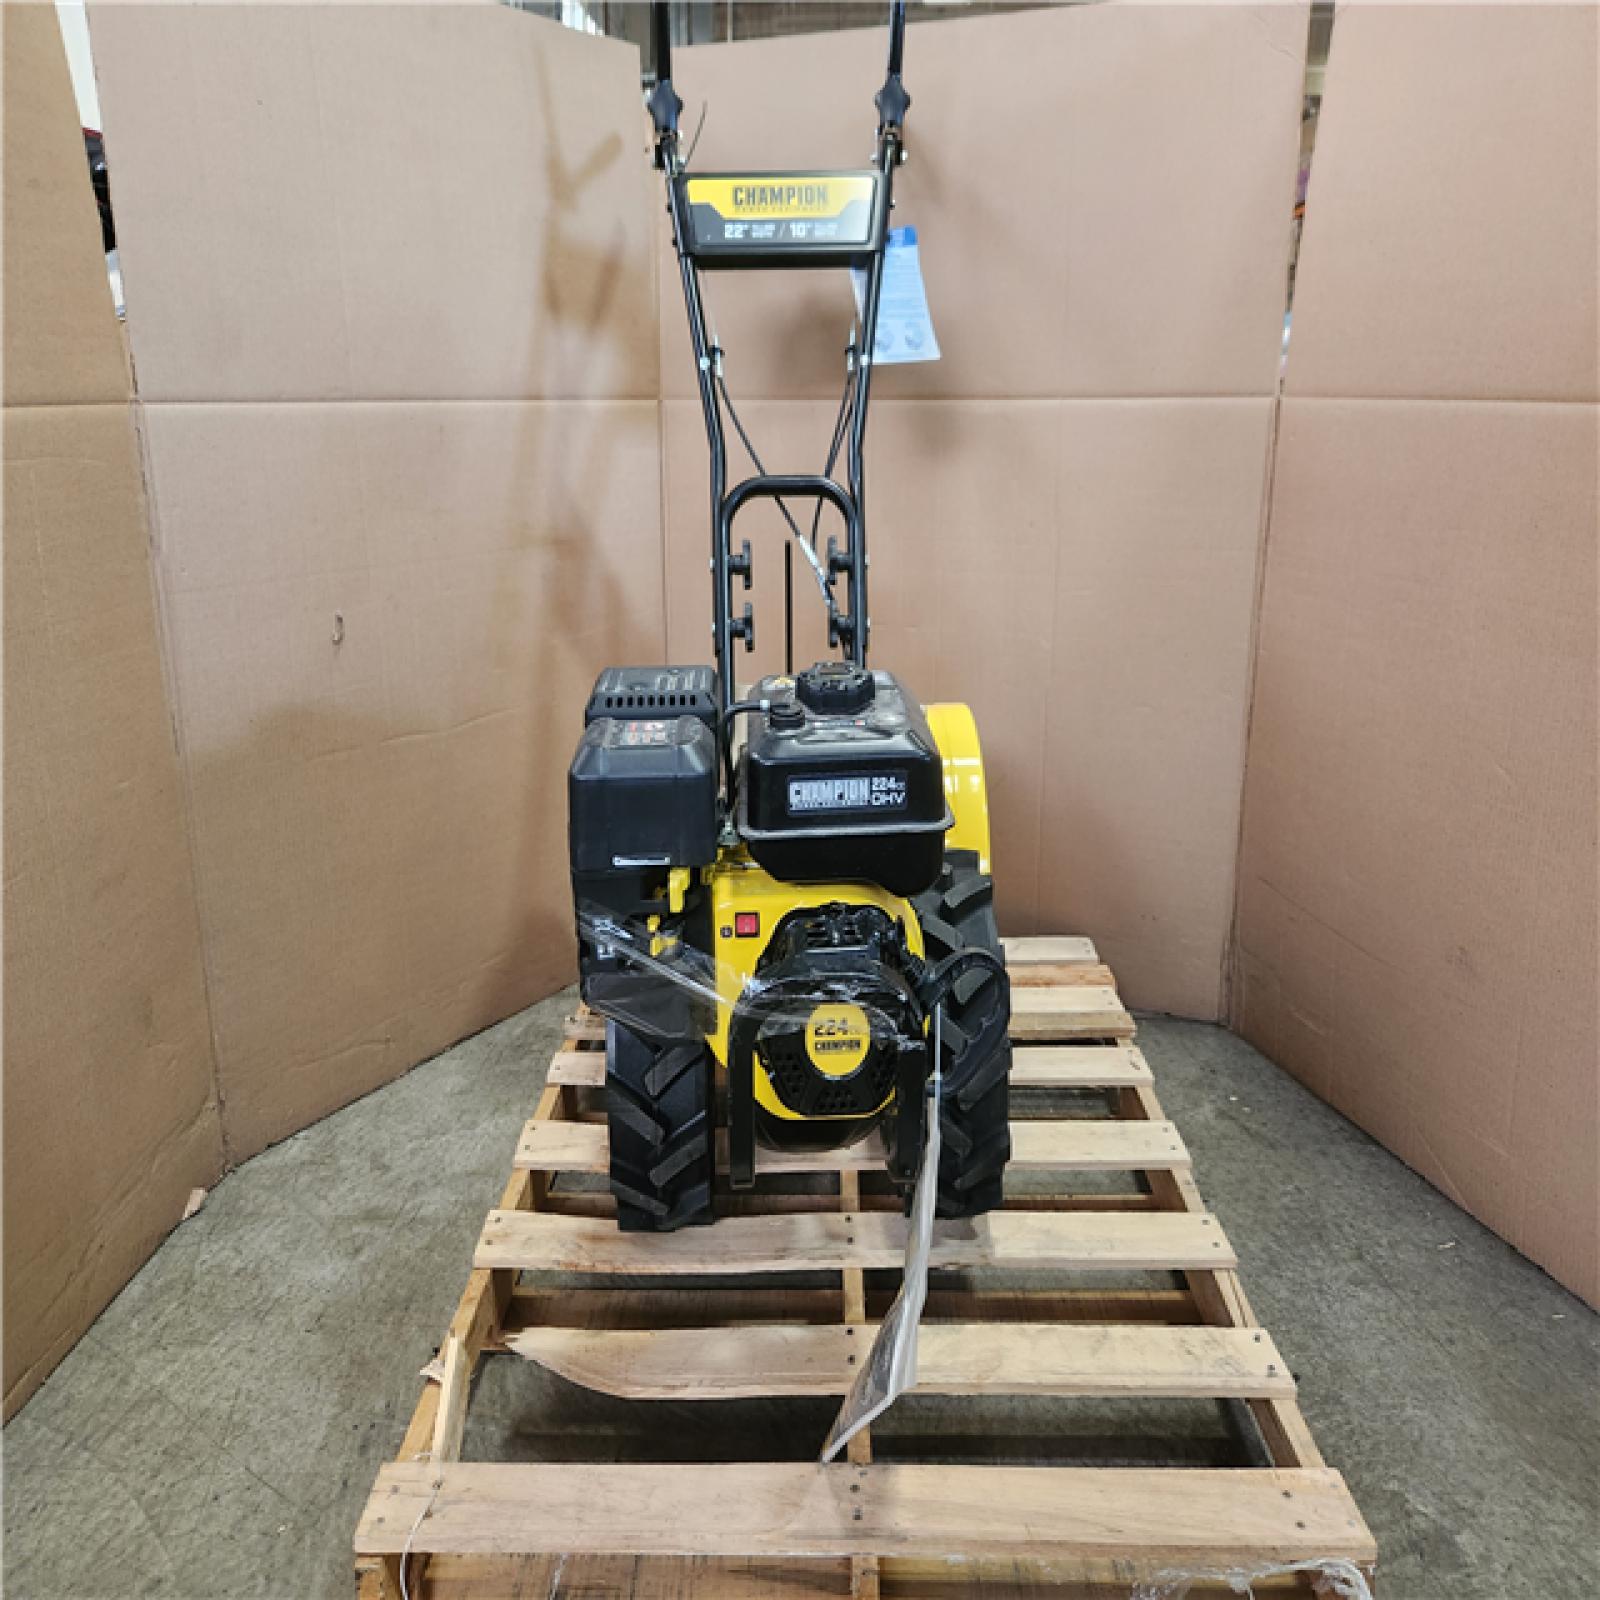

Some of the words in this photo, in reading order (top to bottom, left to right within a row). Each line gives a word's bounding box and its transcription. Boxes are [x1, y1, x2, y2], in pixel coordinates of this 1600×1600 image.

[733, 186, 828, 205] CHAMPION
[789, 779, 870, 801] CHAMPION
[814, 1040, 861, 1051] CHAMPION
